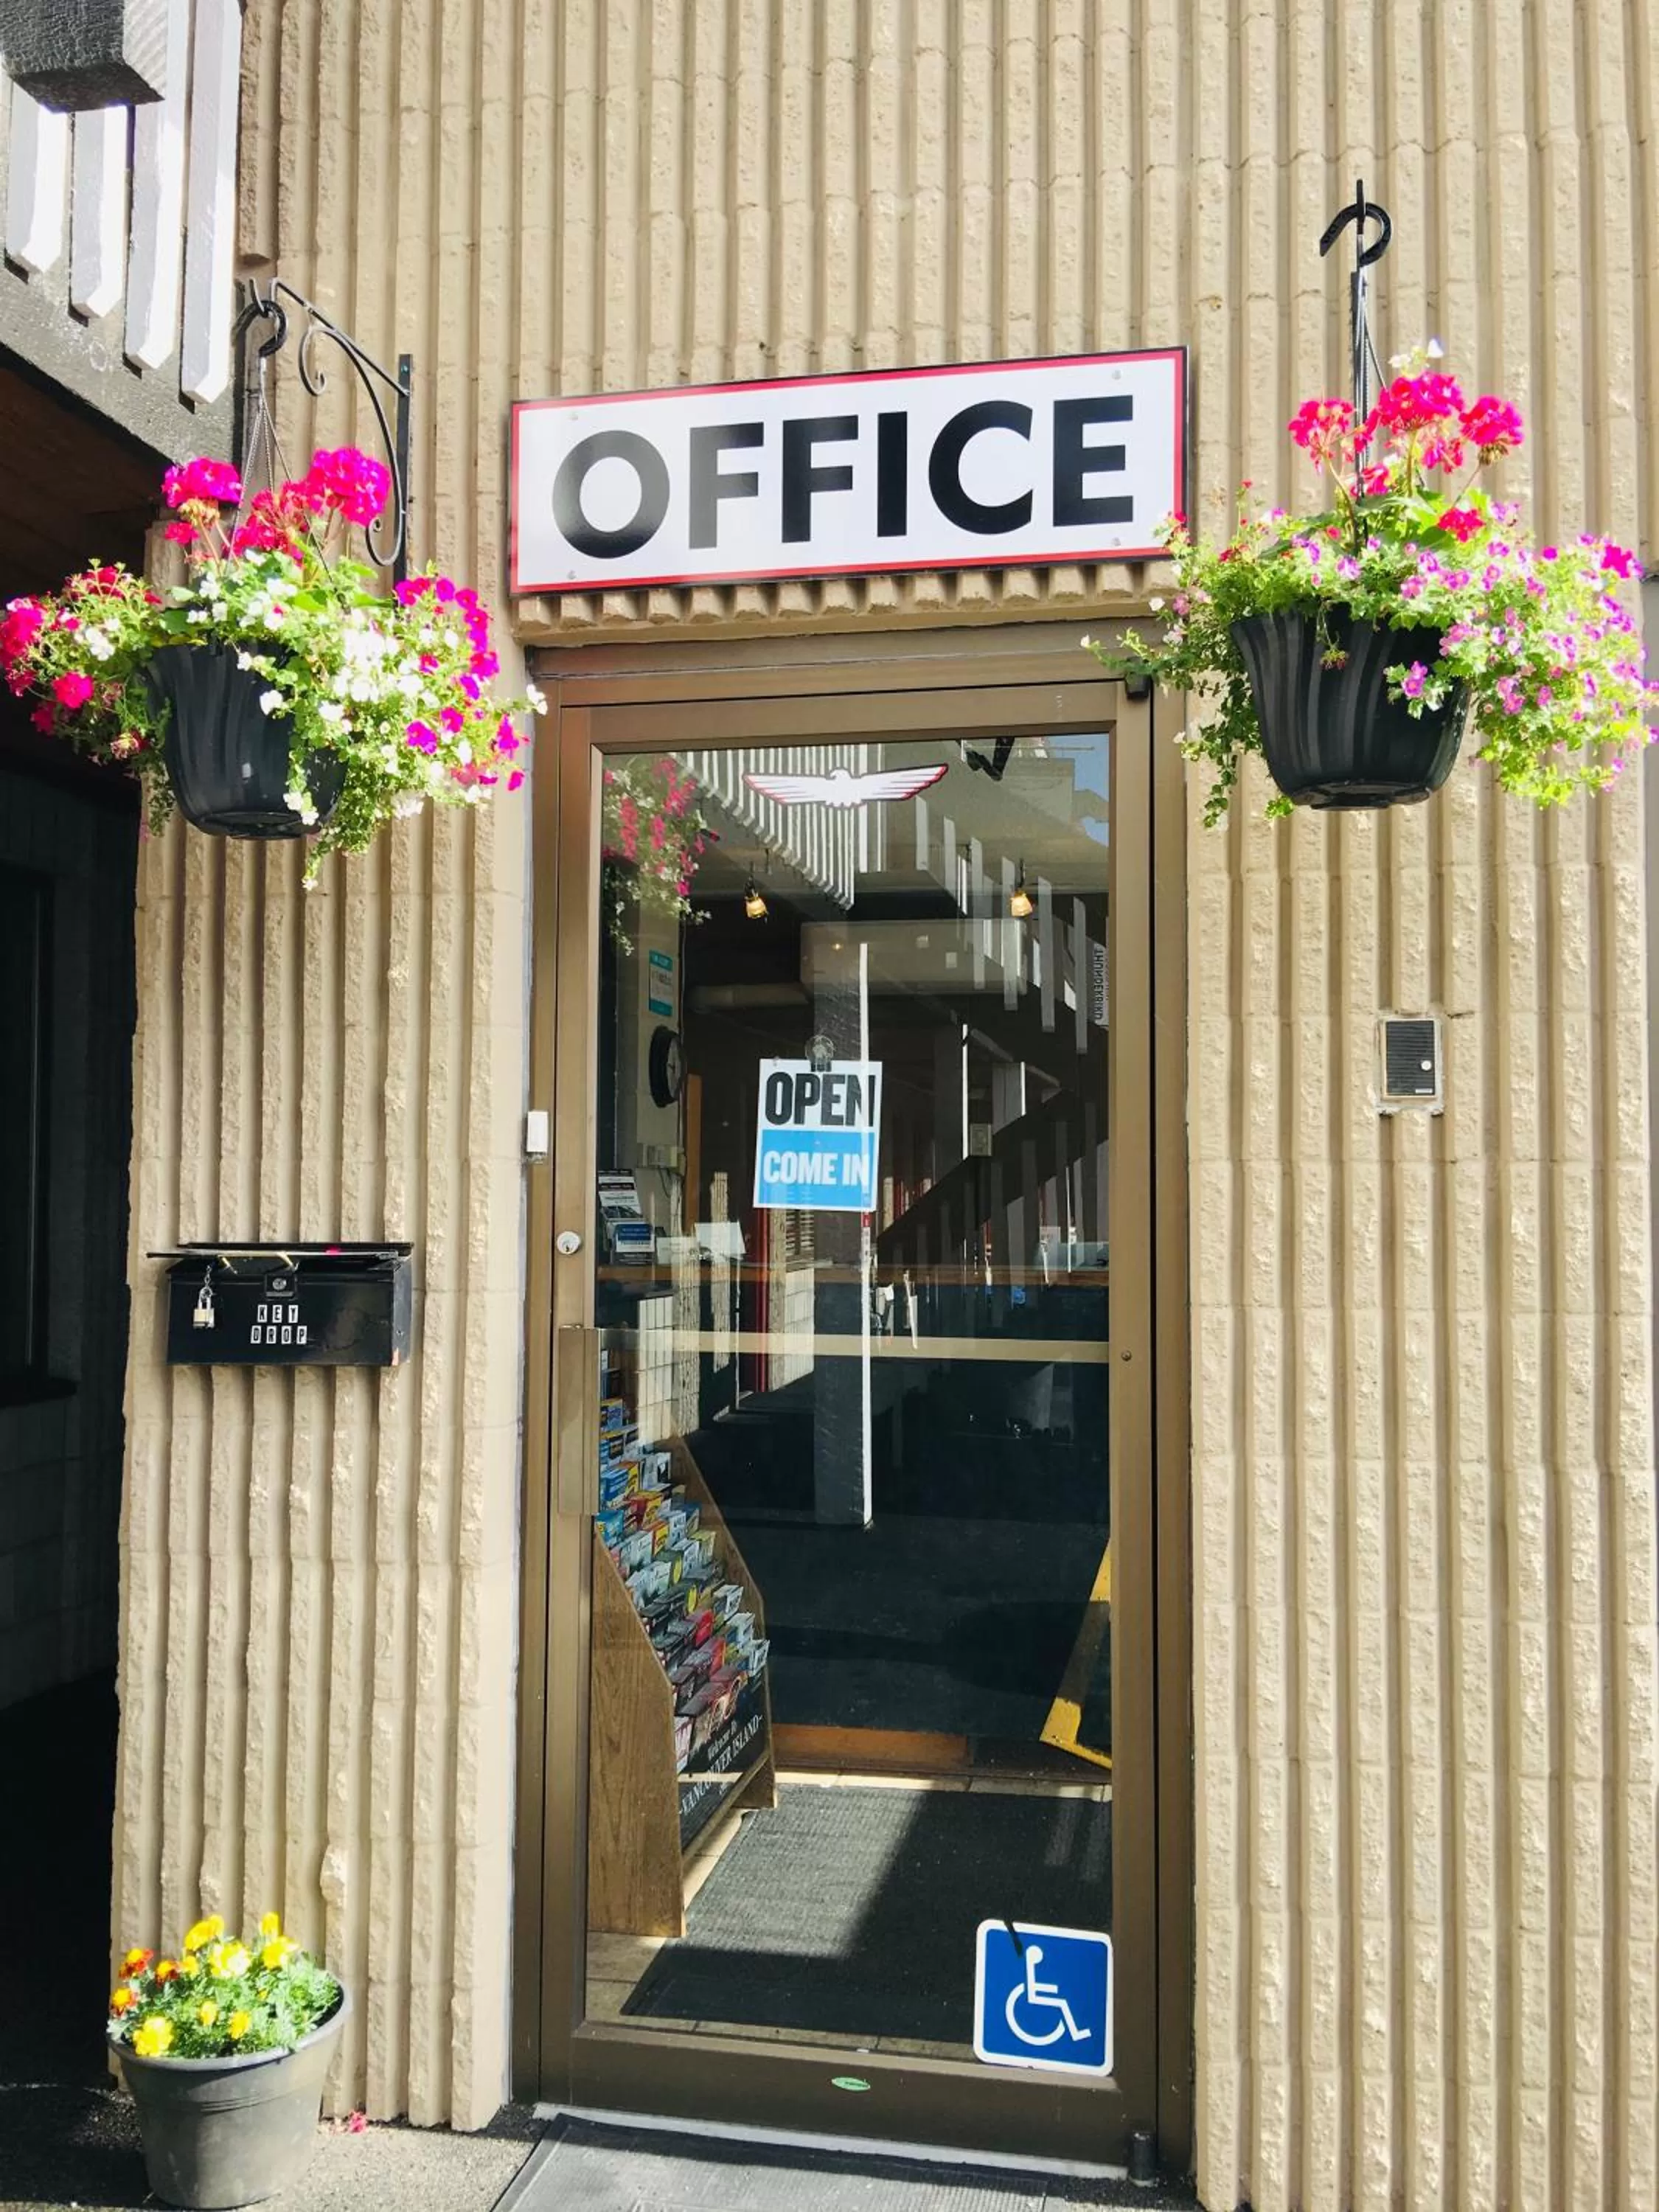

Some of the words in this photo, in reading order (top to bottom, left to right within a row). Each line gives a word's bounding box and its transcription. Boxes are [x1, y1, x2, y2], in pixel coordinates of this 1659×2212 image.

[552, 395, 1134, 560] OFFICE
[765, 1071, 876, 1127] OPEN
[763, 1150, 838, 1186] COME
[843, 1152, 870, 1187] IN
[258, 1305, 297, 1322] KEY
[252, 1326, 306, 1343] DROP
